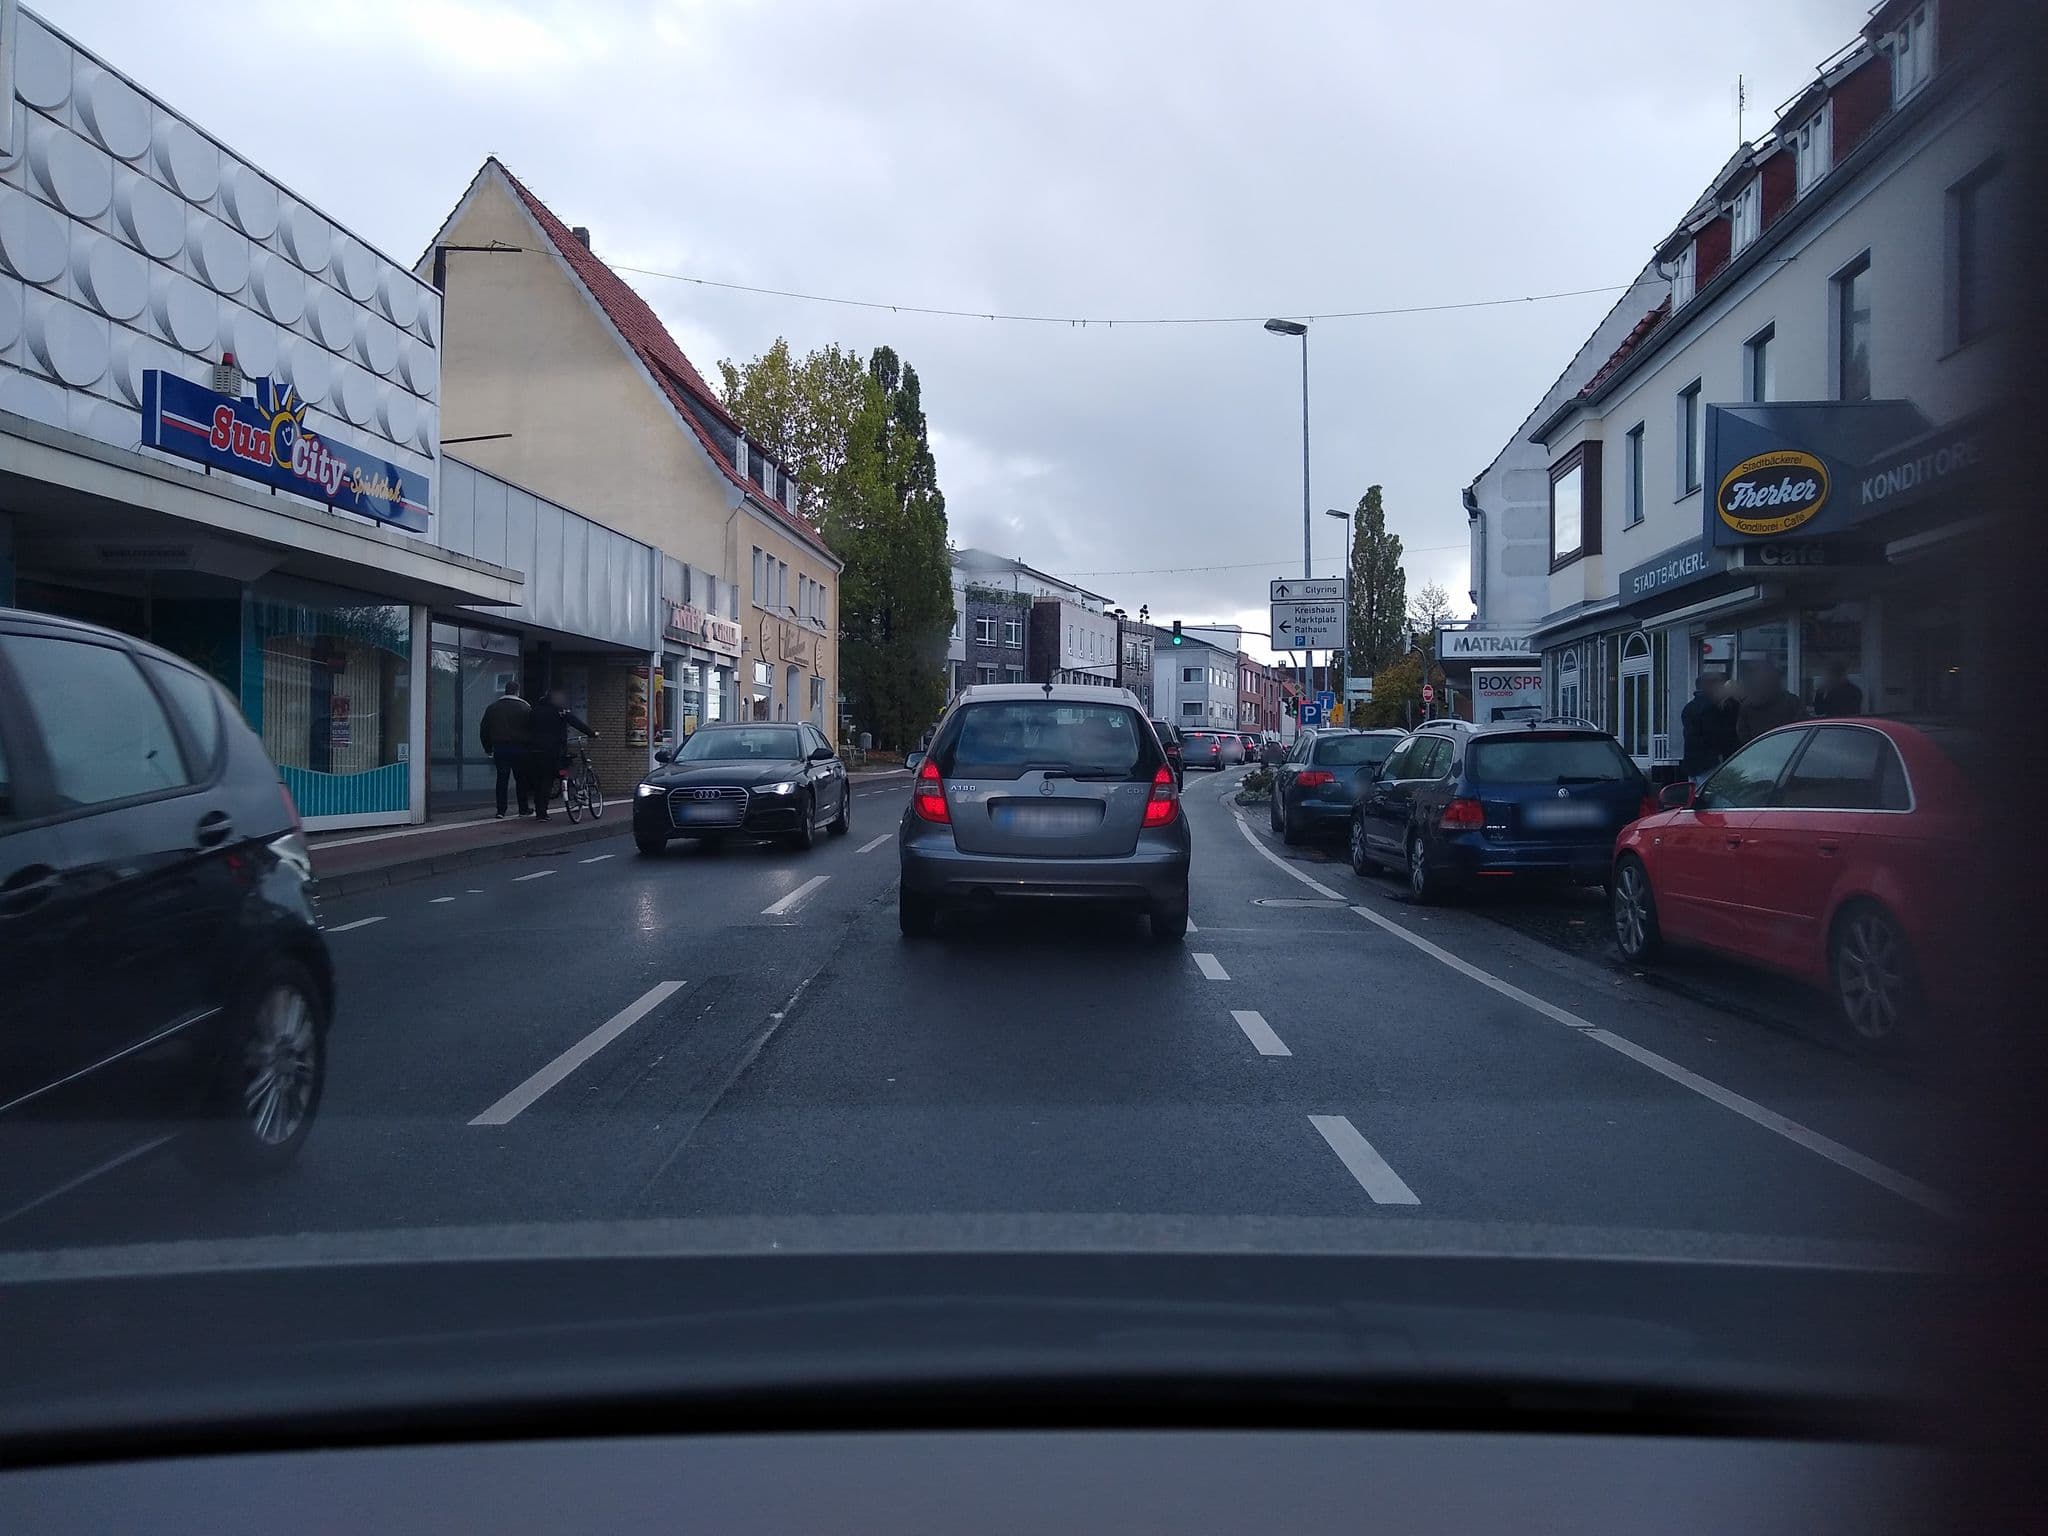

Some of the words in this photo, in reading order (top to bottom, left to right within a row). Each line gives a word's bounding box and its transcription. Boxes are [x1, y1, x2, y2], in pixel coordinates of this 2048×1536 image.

[210, 404, 273, 466] Sun
[1742, 455, 1803, 472] Stadtbäckerei
[1726, 477, 1817, 511] Frerker
[1736, 519, 1779, 532] Konditorei
[1633, 551, 1711, 594] STADTBÄCKER
[1305, 586, 1337, 594] Cityring
[1294, 606, 1336, 614] Kreishaus
[1294, 616, 1337, 624] Marktplatz
[1478, 676, 1542, 690] BOXSPR
[1305, 706, 1317, 722] P
